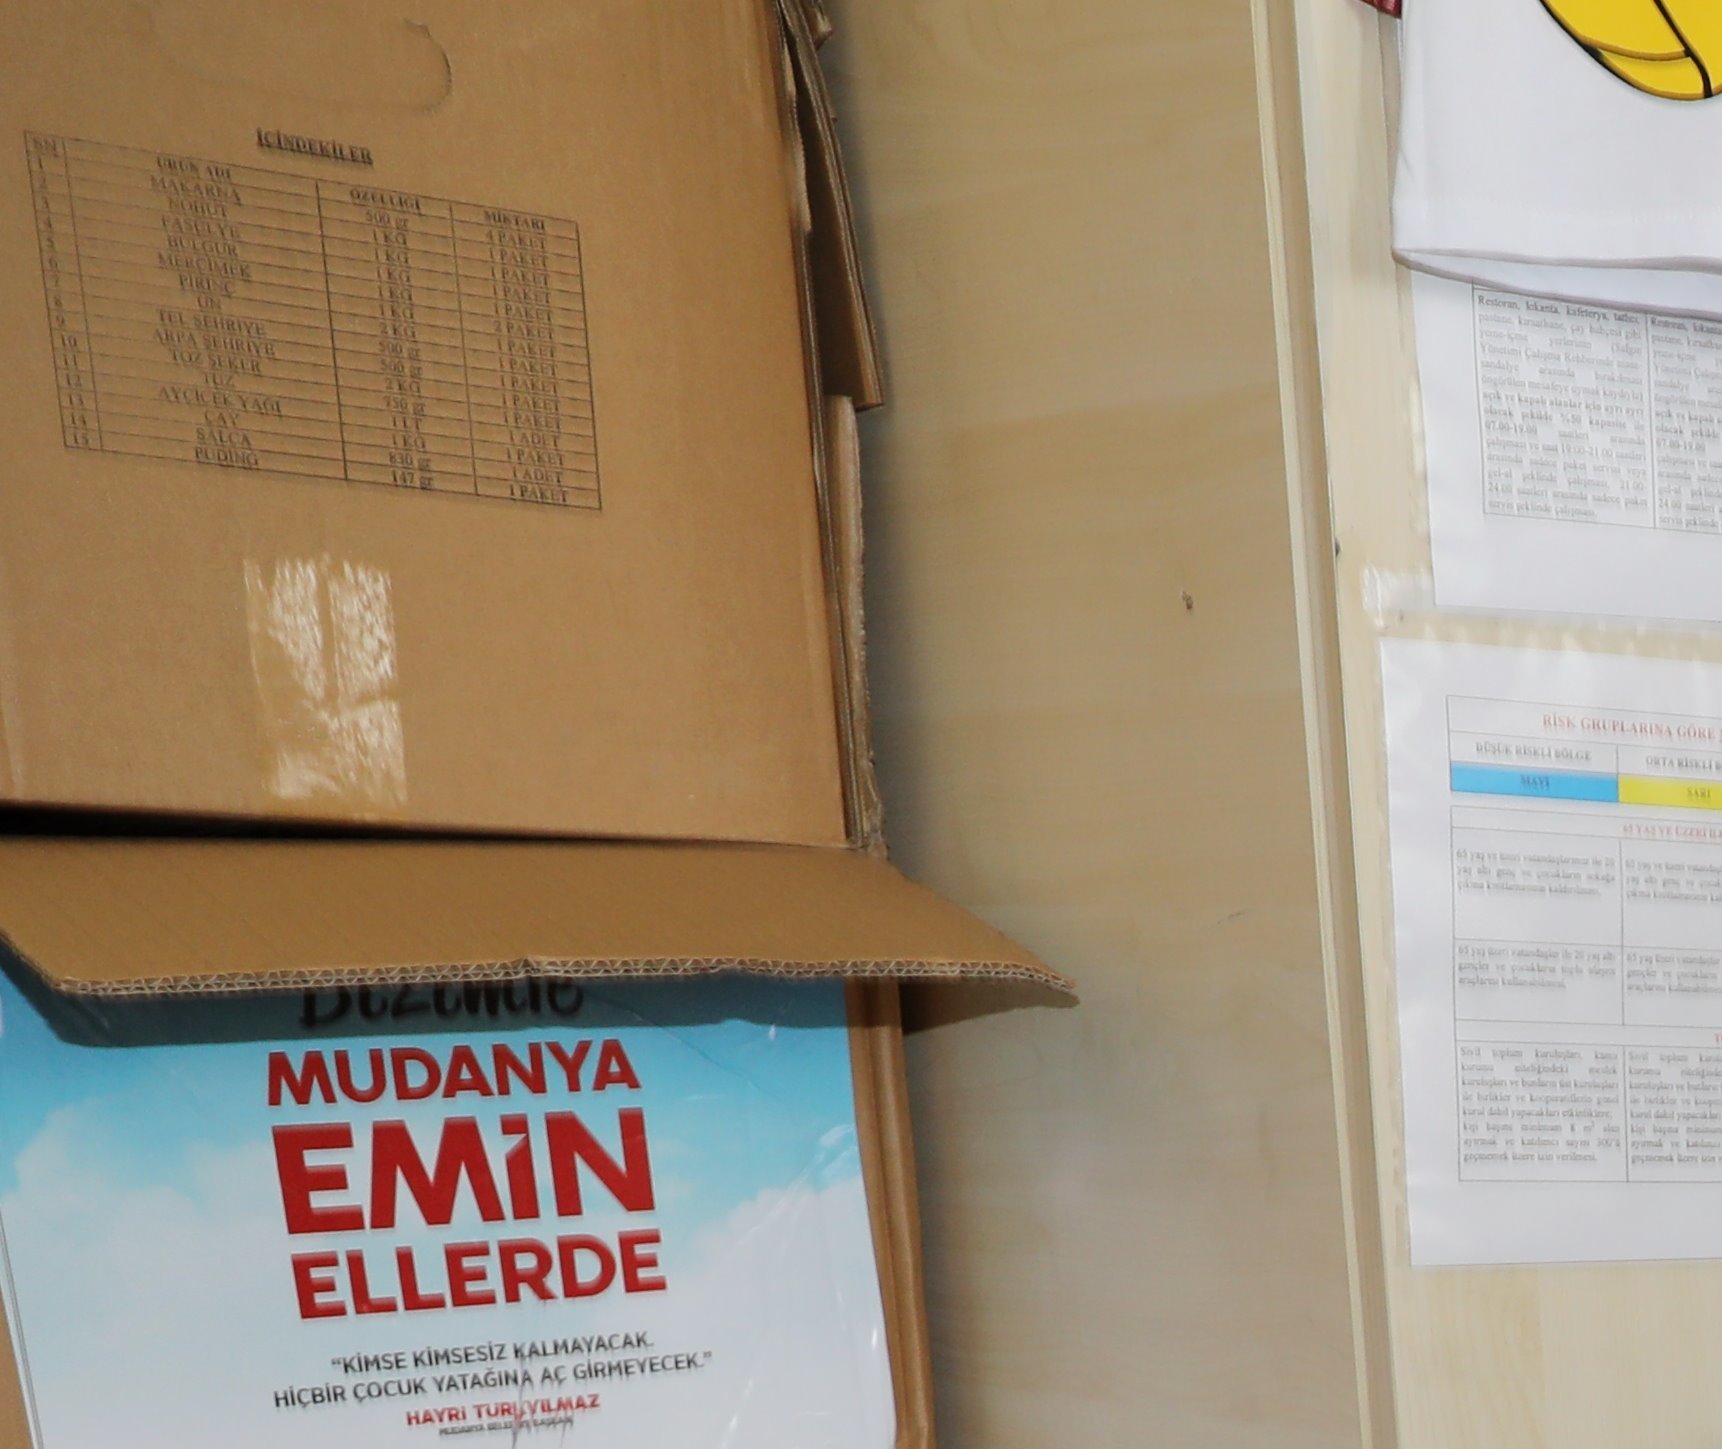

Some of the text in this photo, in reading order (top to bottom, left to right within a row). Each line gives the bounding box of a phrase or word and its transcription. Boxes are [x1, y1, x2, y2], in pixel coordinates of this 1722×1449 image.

[149, 173, 241, 202] MAKARNA
[167, 195, 227, 219] NOHUT
[160, 214, 239, 240] FASULYE
[167, 234, 238, 258] BULGUR
[382, 230, 407, 247] KG
[497, 230, 546, 251] PAKET
[384, 249, 408, 266] KG
[499, 248, 548, 269] PAKET
[386, 267, 410, 284] KG
[501, 267, 549, 287] PAKET
[388, 286, 412, 303] KG
[502, 285, 551, 306] PAKET
[197, 296, 221, 313] UN
[390, 305, 414, 322] KG
[504, 304, 553, 324] PAKET
[157, 309, 186, 326] TEL
[152, 327, 197, 347] ARPA
[392, 324, 416, 340] KG
[506, 322, 554, 342] PAKET
[169, 348, 202, 366] TOZ
[507, 340, 556, 360] PAKET
[509, 359, 557, 378] PAKET
[397, 379, 421, 396] KG
[511, 377, 559, 396] PAKET
[512, 395, 560, 414] PAKET
[514, 413, 562, 432] PAKET
[403, 434, 427, 450] KG
[519, 431, 560, 449] ADET
[517, 449, 565, 467] PAKET
[522, 467, 563, 485] ADET
[520, 485, 568, 503] PAKET
[1542, 712, 1576, 729] RİSK
[1581, 716, 1672, 738] GRUPLARINA
[1677, 721, 1715, 741] GÖRE
[267, 1038, 642, 1107] MUDANYA
[271, 1106, 657, 1235] EMİN
[290, 1228, 668, 1319] ELLERDE
[413, 1341, 506, 1368] KİMSESİZ
[274, 1382, 347, 1408] HİÇBİR
[353, 1378, 427, 1403] ÇOCUK
[432, 1367, 535, 1393] YATAĞINA
[541, 1365, 567, 1386] AÇ
